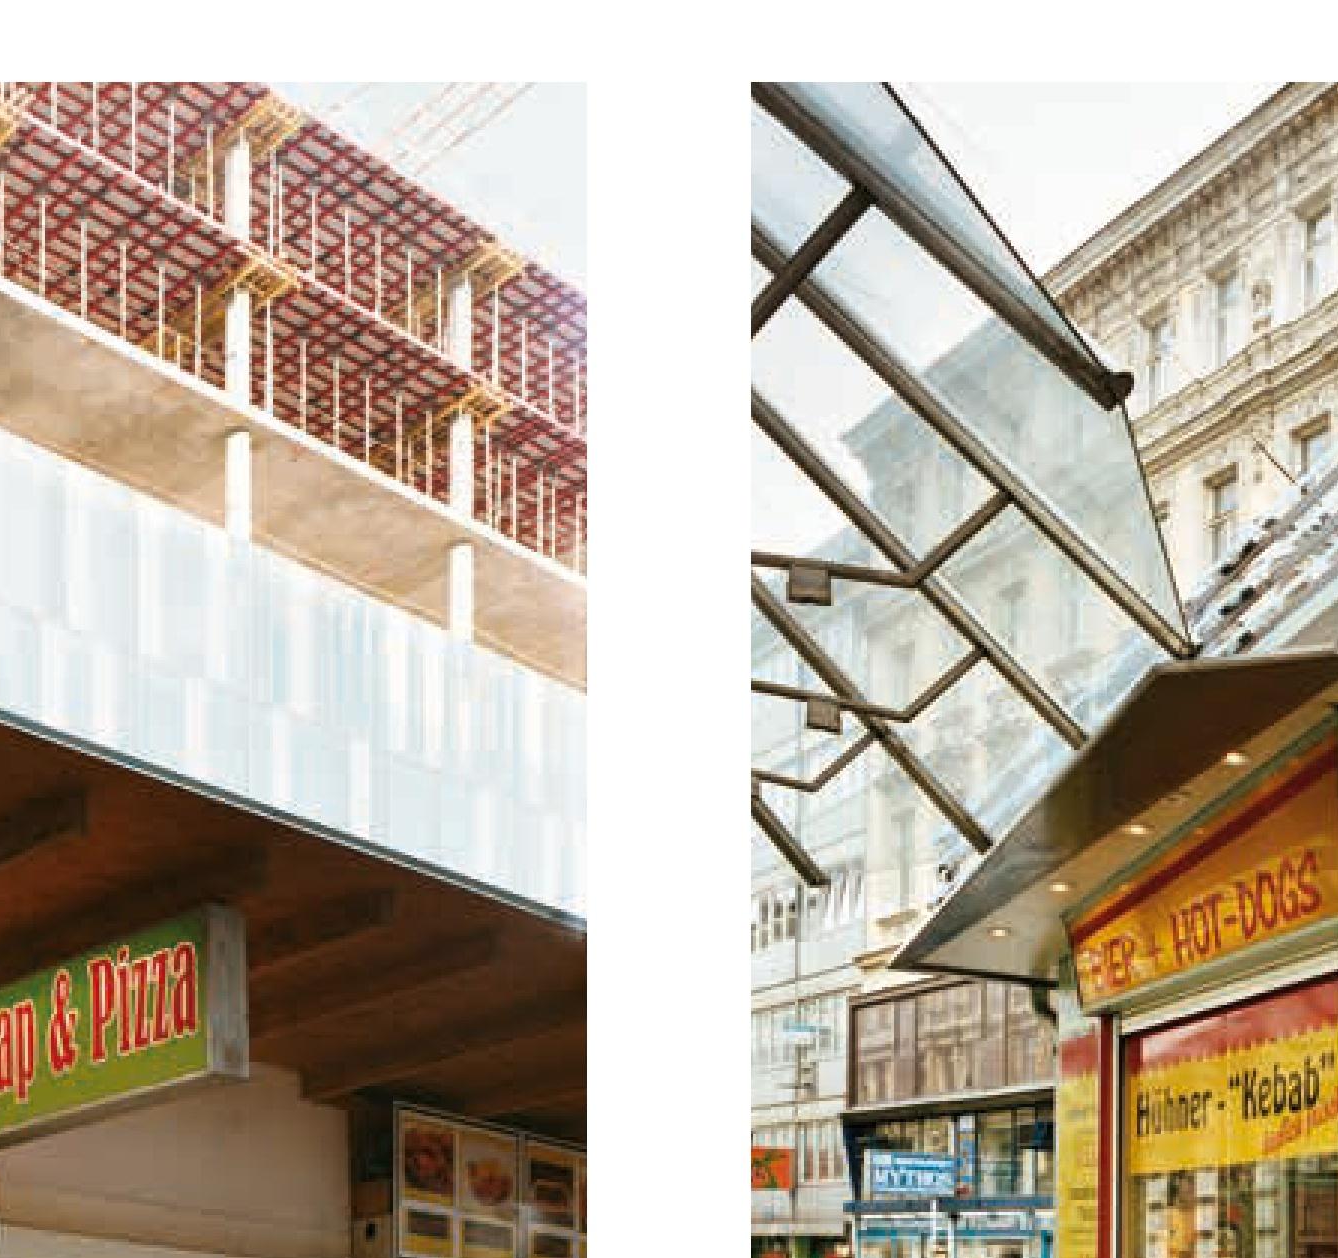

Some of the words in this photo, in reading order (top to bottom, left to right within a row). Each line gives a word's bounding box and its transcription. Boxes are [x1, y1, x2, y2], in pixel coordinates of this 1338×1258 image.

[1171, 849, 1323, 967] HOT-DOGS
[48, 969, 79, 1075] &
[88, 941, 201, 1063] Pizza
[1136, 1087, 1212, 1138] Hühner
